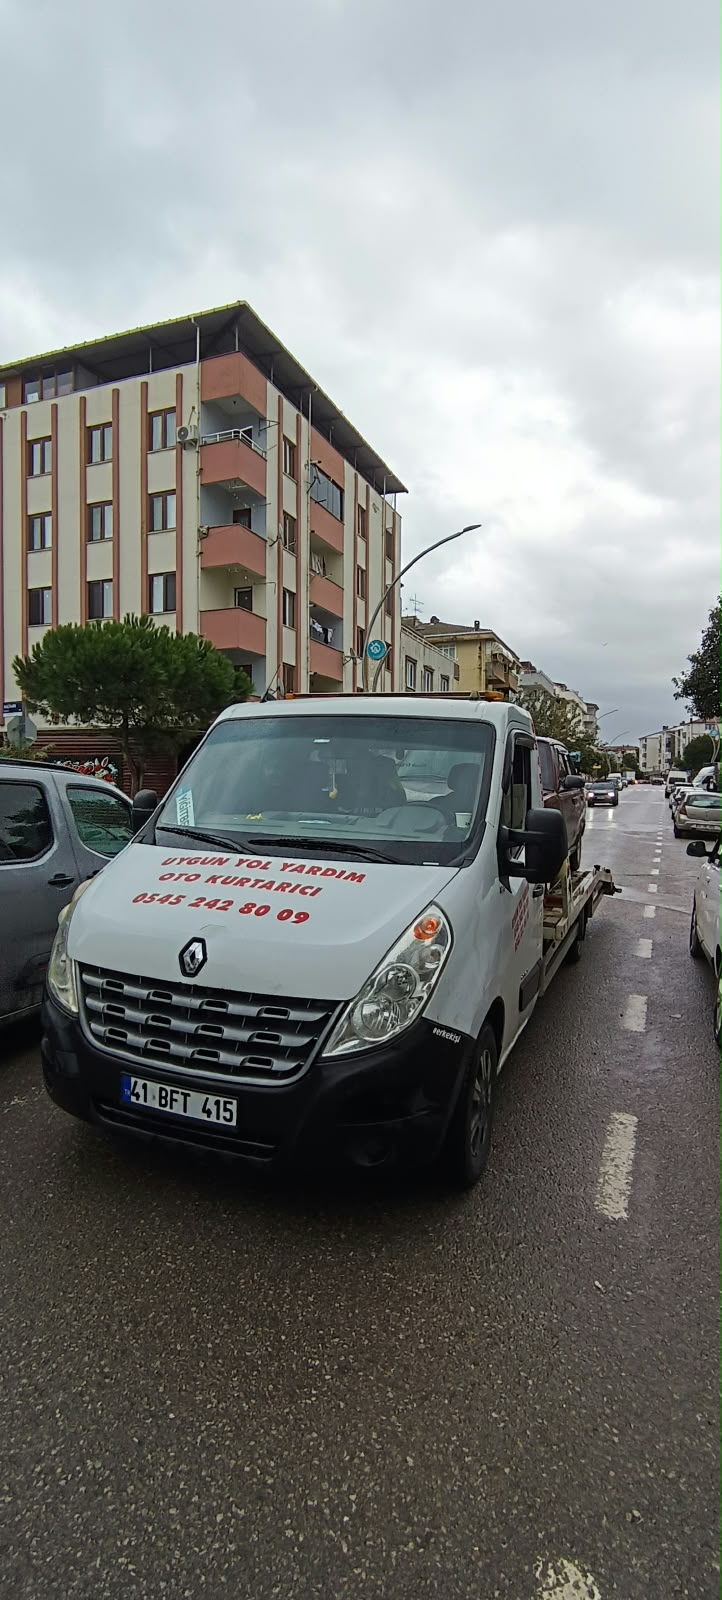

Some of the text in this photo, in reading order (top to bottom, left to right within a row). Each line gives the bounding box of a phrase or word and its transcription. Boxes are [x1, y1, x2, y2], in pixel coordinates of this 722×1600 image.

[158, 872, 323, 897] OTO KURTARICI
[160, 856, 366, 884] UYGUN YOL YARDIM
[132, 892, 310, 925] 0545 242 80 09
[131, 1080, 234, 1123] 41 BFT 415
